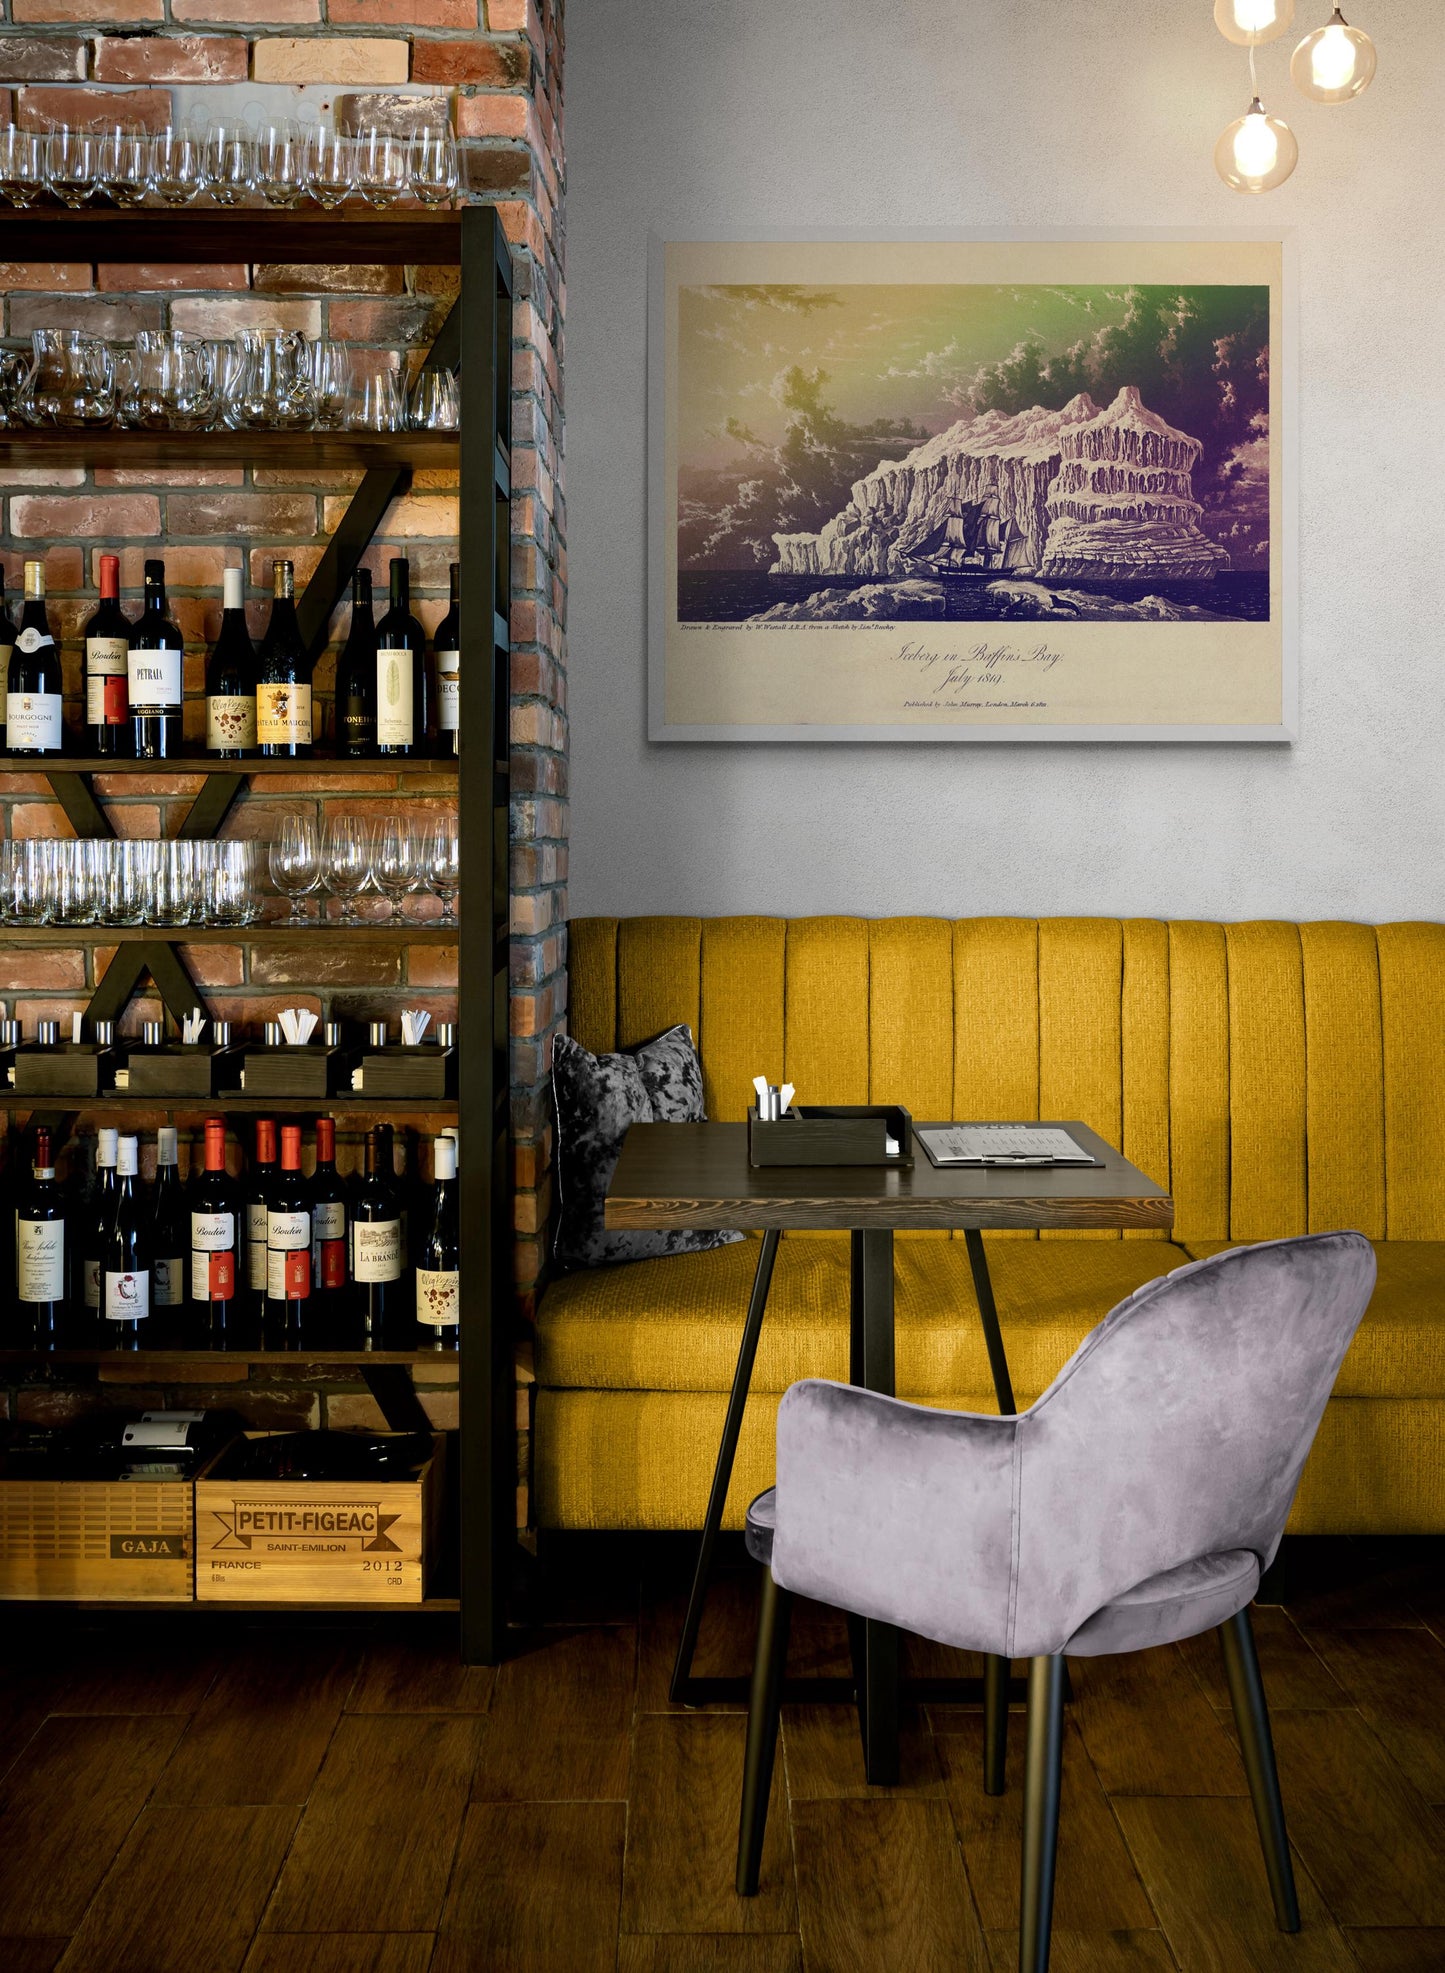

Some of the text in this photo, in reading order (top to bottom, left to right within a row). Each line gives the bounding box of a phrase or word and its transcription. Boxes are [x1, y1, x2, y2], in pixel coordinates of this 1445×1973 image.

[890, 641, 939, 672] Iceberg
[943, 645, 959, 662] in
[136, 667, 163, 681] PETRAIA
[932, 664, 973, 694] July
[8, 713, 53, 721] BOURGOGNE
[196, 1226, 226, 1236] Bordón
[272, 1225, 302, 1235] Bordón
[360, 1251, 370, 1262] LA
[372, 1249, 399, 1262] BRANDE
[239, 1511, 375, 1532] PETIT-FIGEAC
[121, 1541, 172, 1554] GAJA
[267, 1543, 347, 1552] SAINT-EMILION
[211, 1560, 262, 1570] FRANCE
[362, 1560, 403, 1572] 2012
